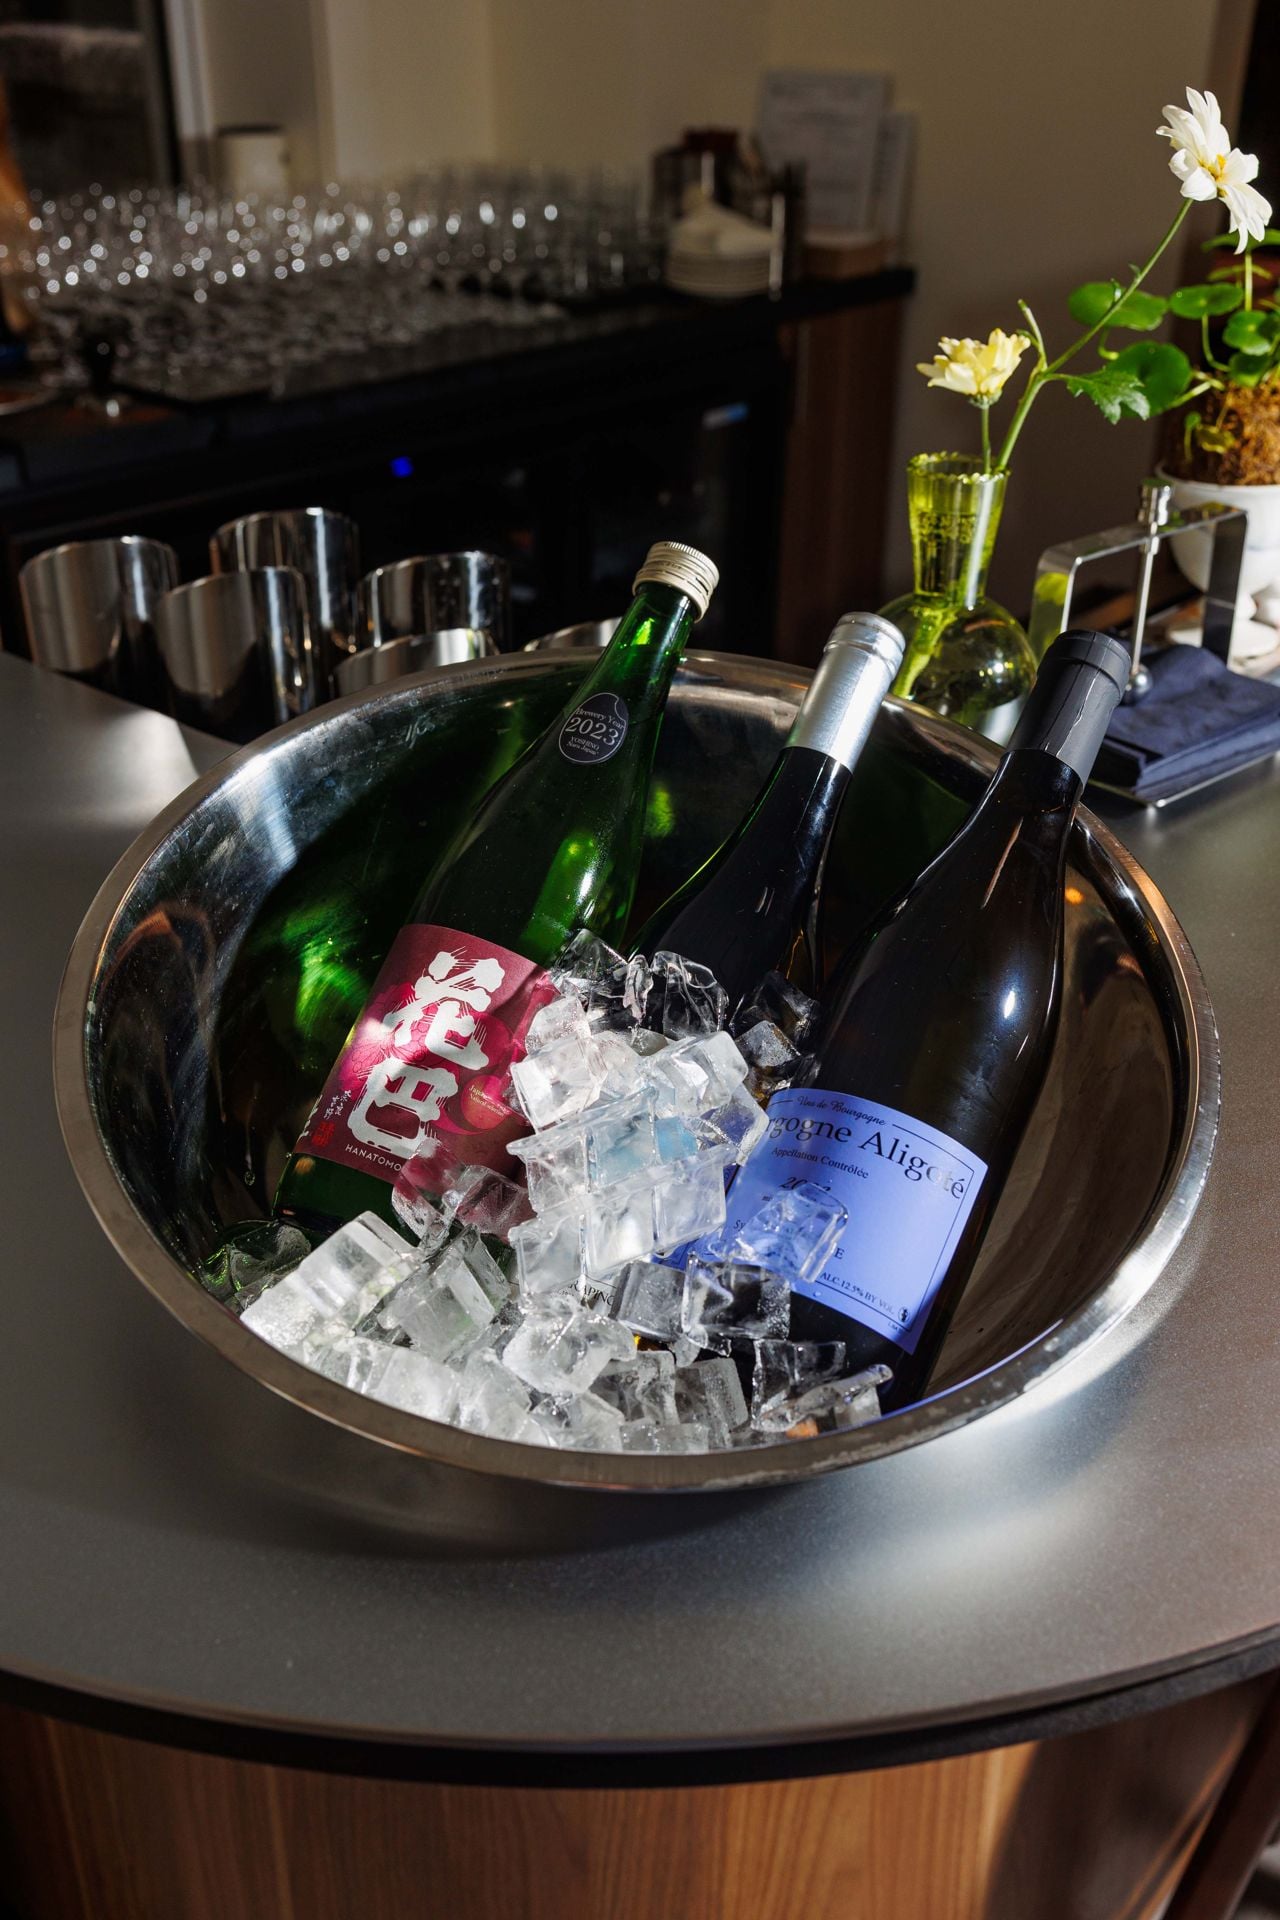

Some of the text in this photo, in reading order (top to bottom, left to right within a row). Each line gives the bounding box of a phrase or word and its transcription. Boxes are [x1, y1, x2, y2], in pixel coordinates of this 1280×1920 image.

[565, 717, 619, 746] 2023
[608, 715, 625, 730] Year
[571, 736, 600, 751] YOSHINO
[830, 1100, 887, 1126] Bourgogne
[345, 1143, 402, 1171] HANATOMO
[766, 1117, 965, 1199] rgogne Aligoté
[771, 1147, 869, 1179] Appellation Contrôlée
